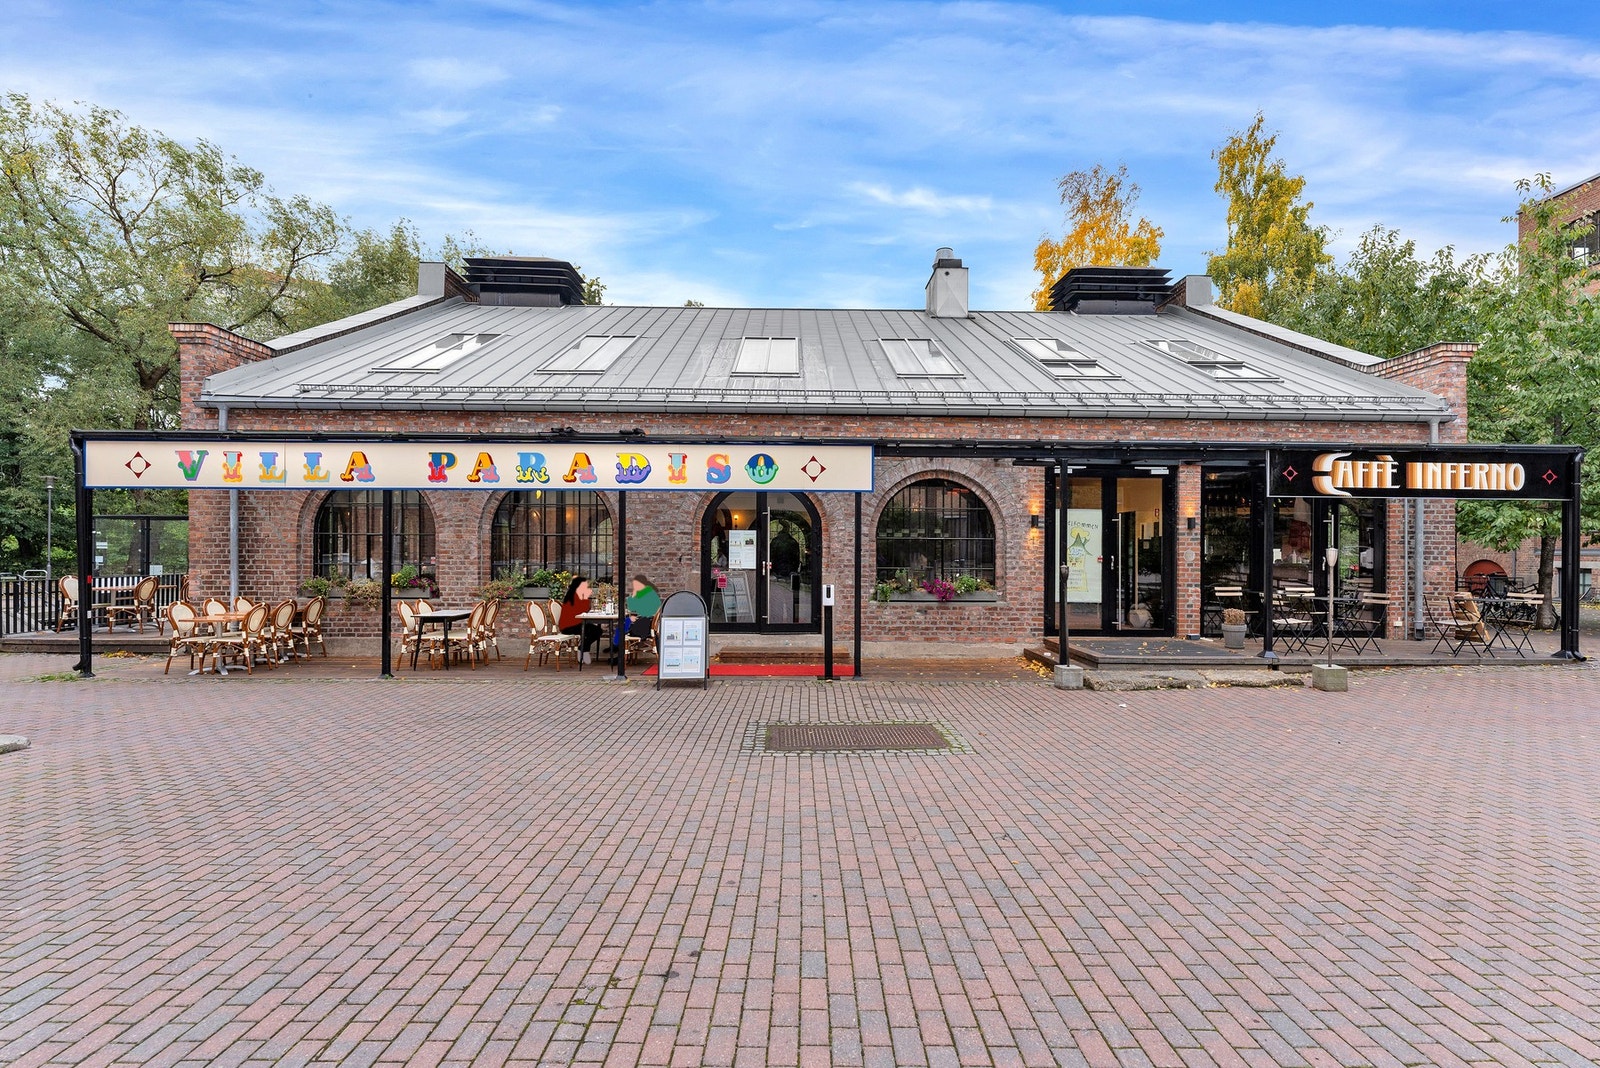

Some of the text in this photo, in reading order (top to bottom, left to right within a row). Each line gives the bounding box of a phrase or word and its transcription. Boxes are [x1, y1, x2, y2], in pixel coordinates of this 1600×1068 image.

[174, 450, 780, 485] VILLA PARADISO
[1312, 452, 1526, 497] CAFFÈ INFERNO
